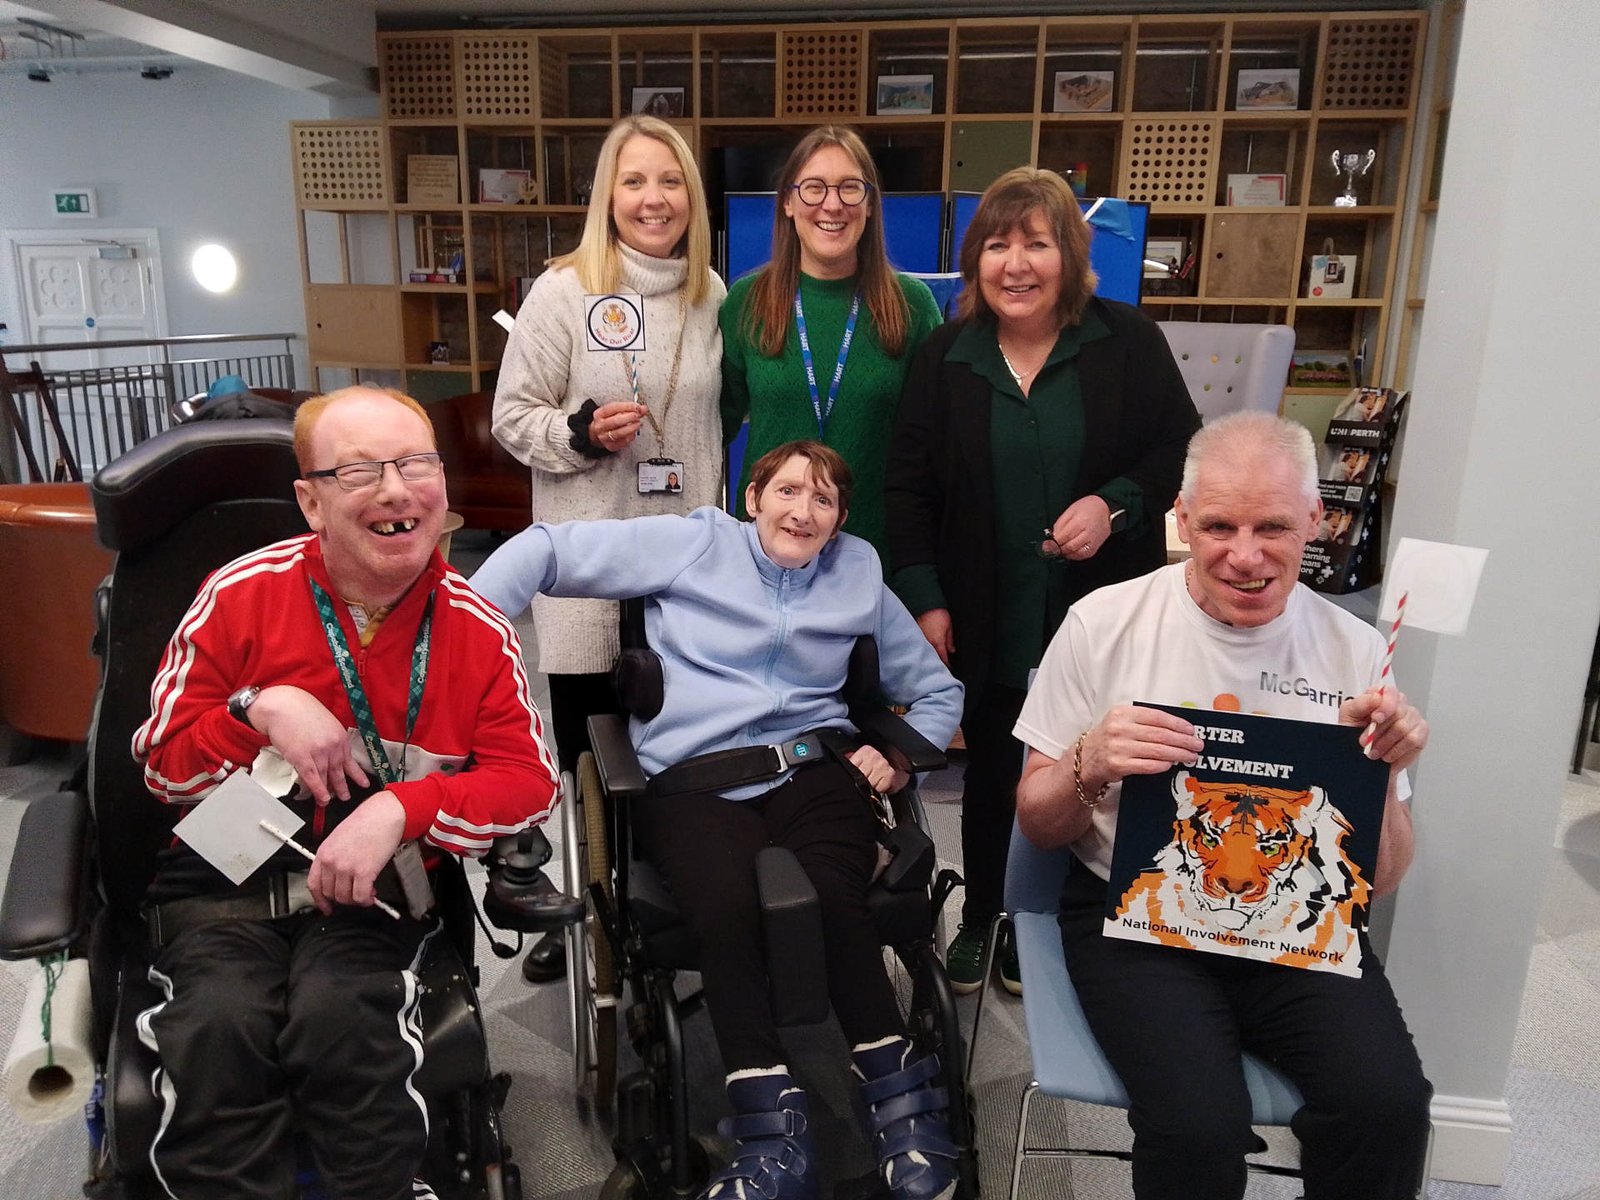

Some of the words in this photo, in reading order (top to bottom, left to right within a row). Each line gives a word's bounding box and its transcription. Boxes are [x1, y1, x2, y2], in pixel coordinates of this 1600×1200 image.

[794, 299, 804, 317] HART
[800, 332, 809, 351] HART
[806, 366, 816, 386] HART
[833, 362, 844, 382] HART
[842, 328, 853, 349] HART
[1350, 428, 1380, 438] PERTH
[1301, 559, 1321, 568] eans
[1260, 671, 1355, 709] McGarri
[1193, 725, 1245, 744] RTER
[1122, 917, 1182, 935] National
[1186, 927, 1276, 950] Involvement
[1279, 942, 1344, 963] Network
